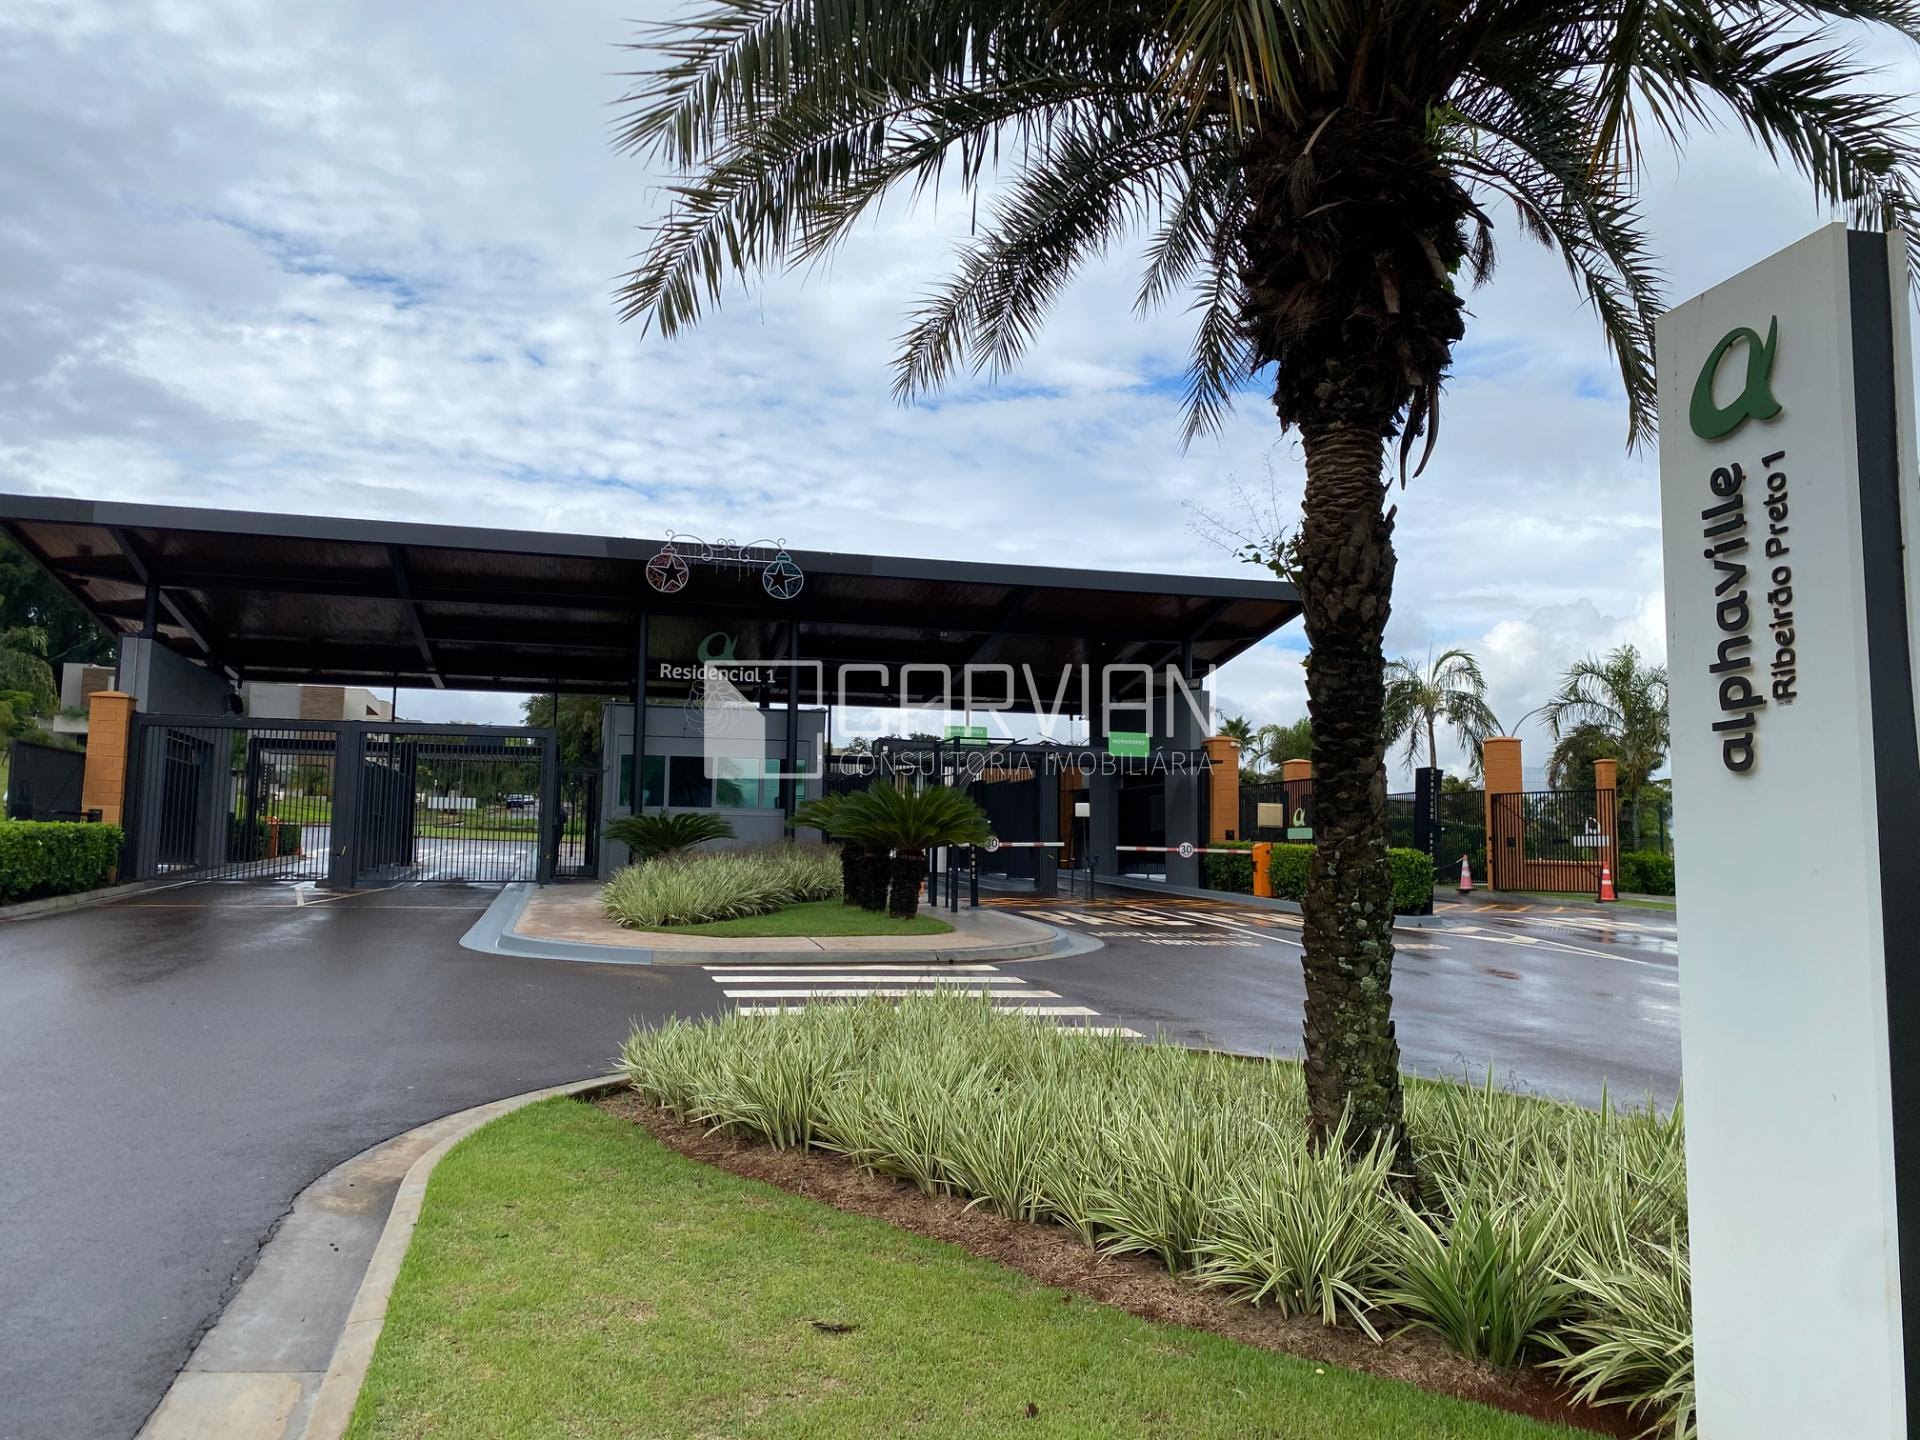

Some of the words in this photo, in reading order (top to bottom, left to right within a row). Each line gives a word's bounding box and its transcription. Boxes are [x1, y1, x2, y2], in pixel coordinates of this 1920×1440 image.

[1761, 450, 1786, 468] 1
[1762, 472, 1790, 559] Preto
[1700, 460, 1767, 775] alphaville
[1766, 563, 1798, 700] Ribeirão
[660, 663, 762, 683] Residencial
[766, 669, 776, 683] 1
[1180, 845, 1192, 854] 30
